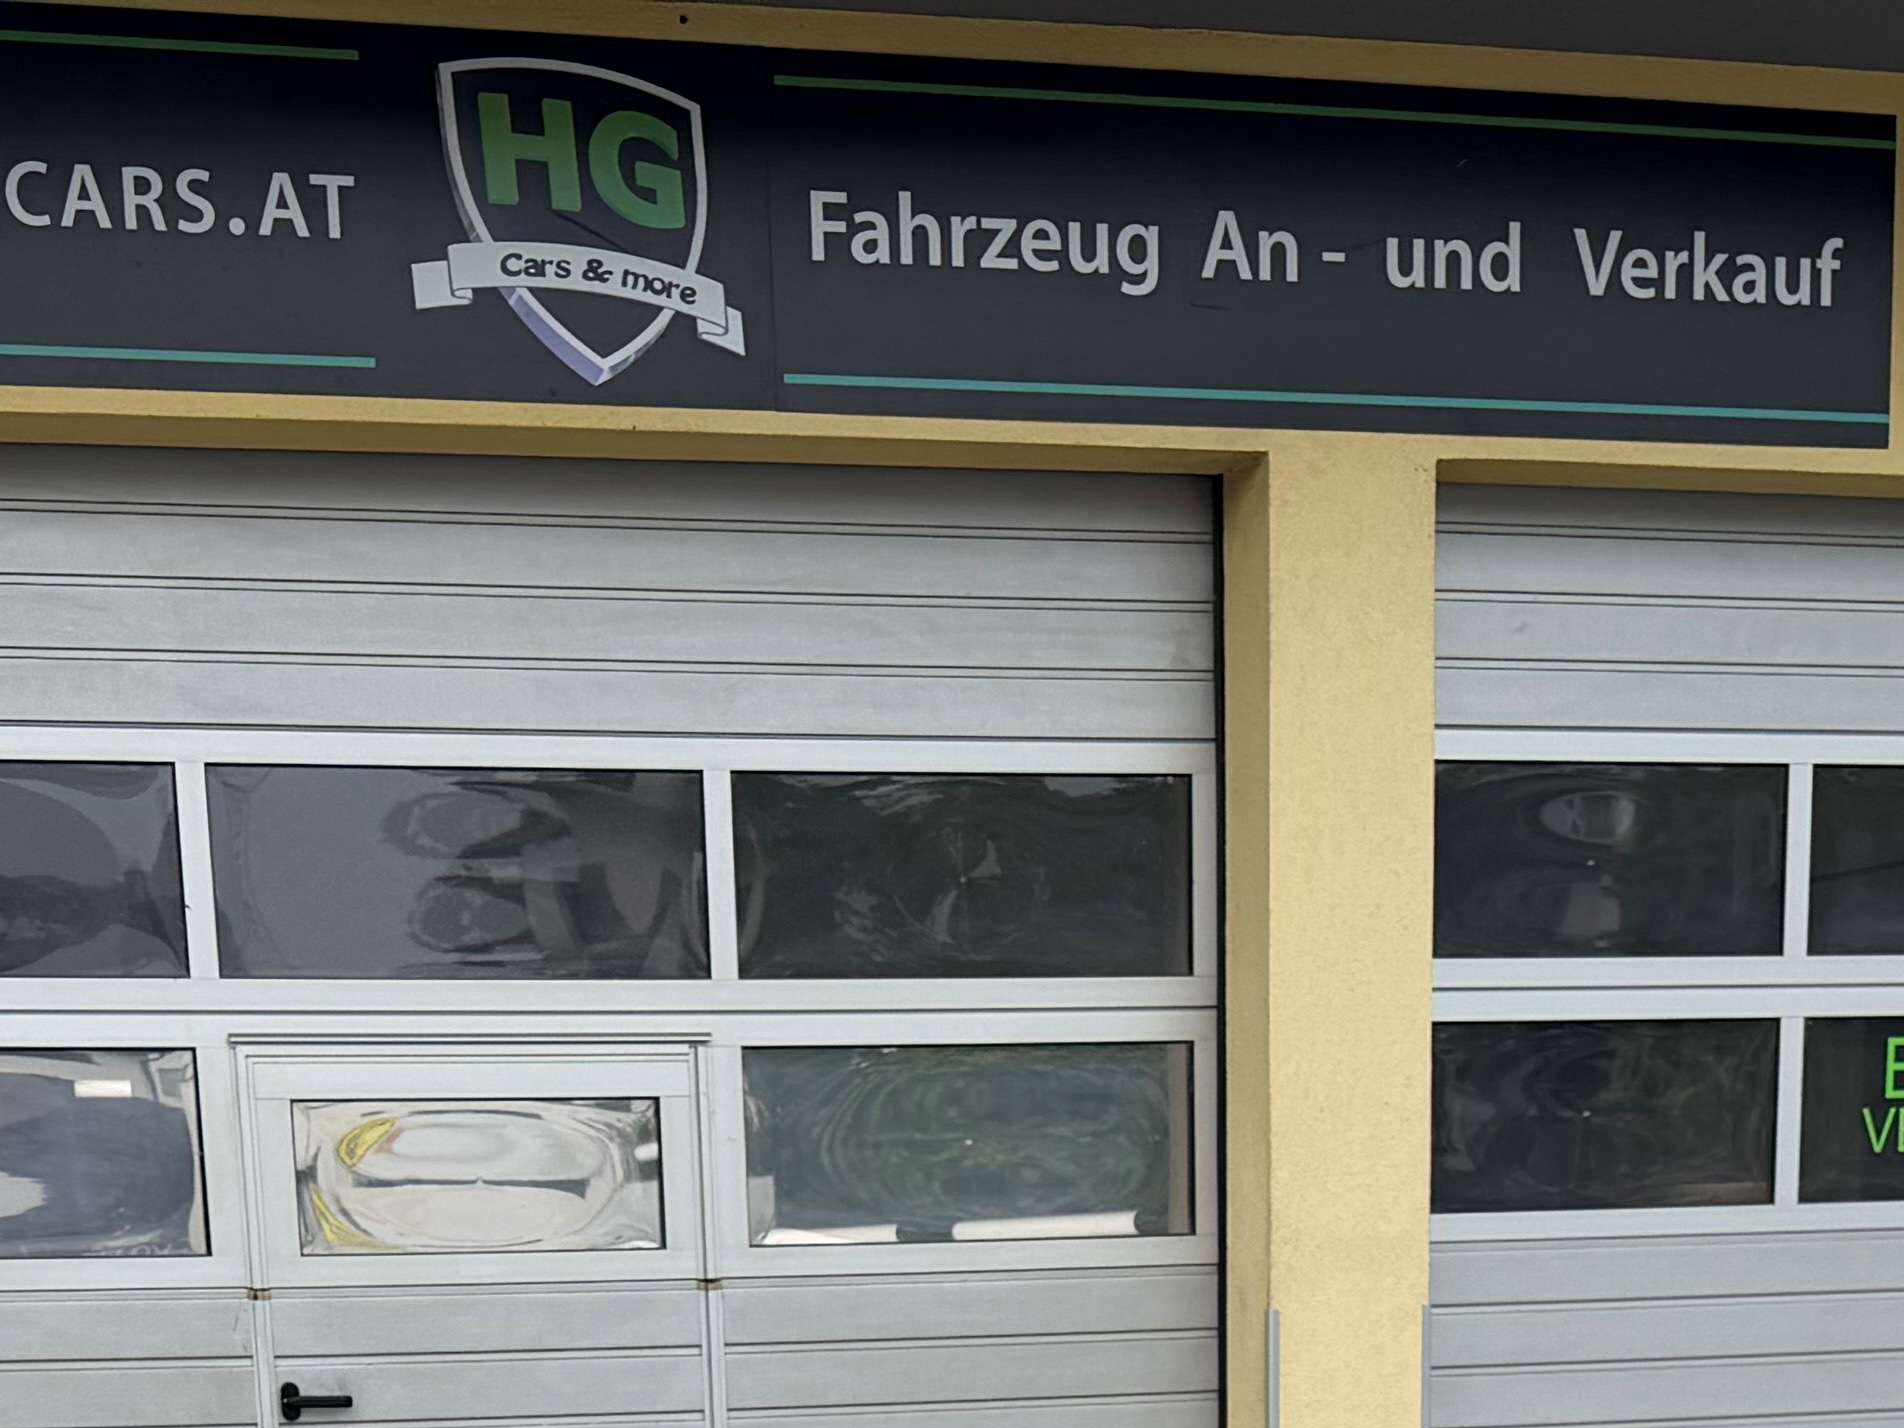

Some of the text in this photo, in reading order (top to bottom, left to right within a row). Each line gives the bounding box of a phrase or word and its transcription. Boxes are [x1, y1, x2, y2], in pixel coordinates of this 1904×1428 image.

[477, 92, 686, 230] HG
[499, 252, 698, 306] Cars & more
[807, 189, 1161, 297] Fahrzeug
[1384, 221, 1523, 294] und
[1572, 228, 1844, 308] Verkauf
